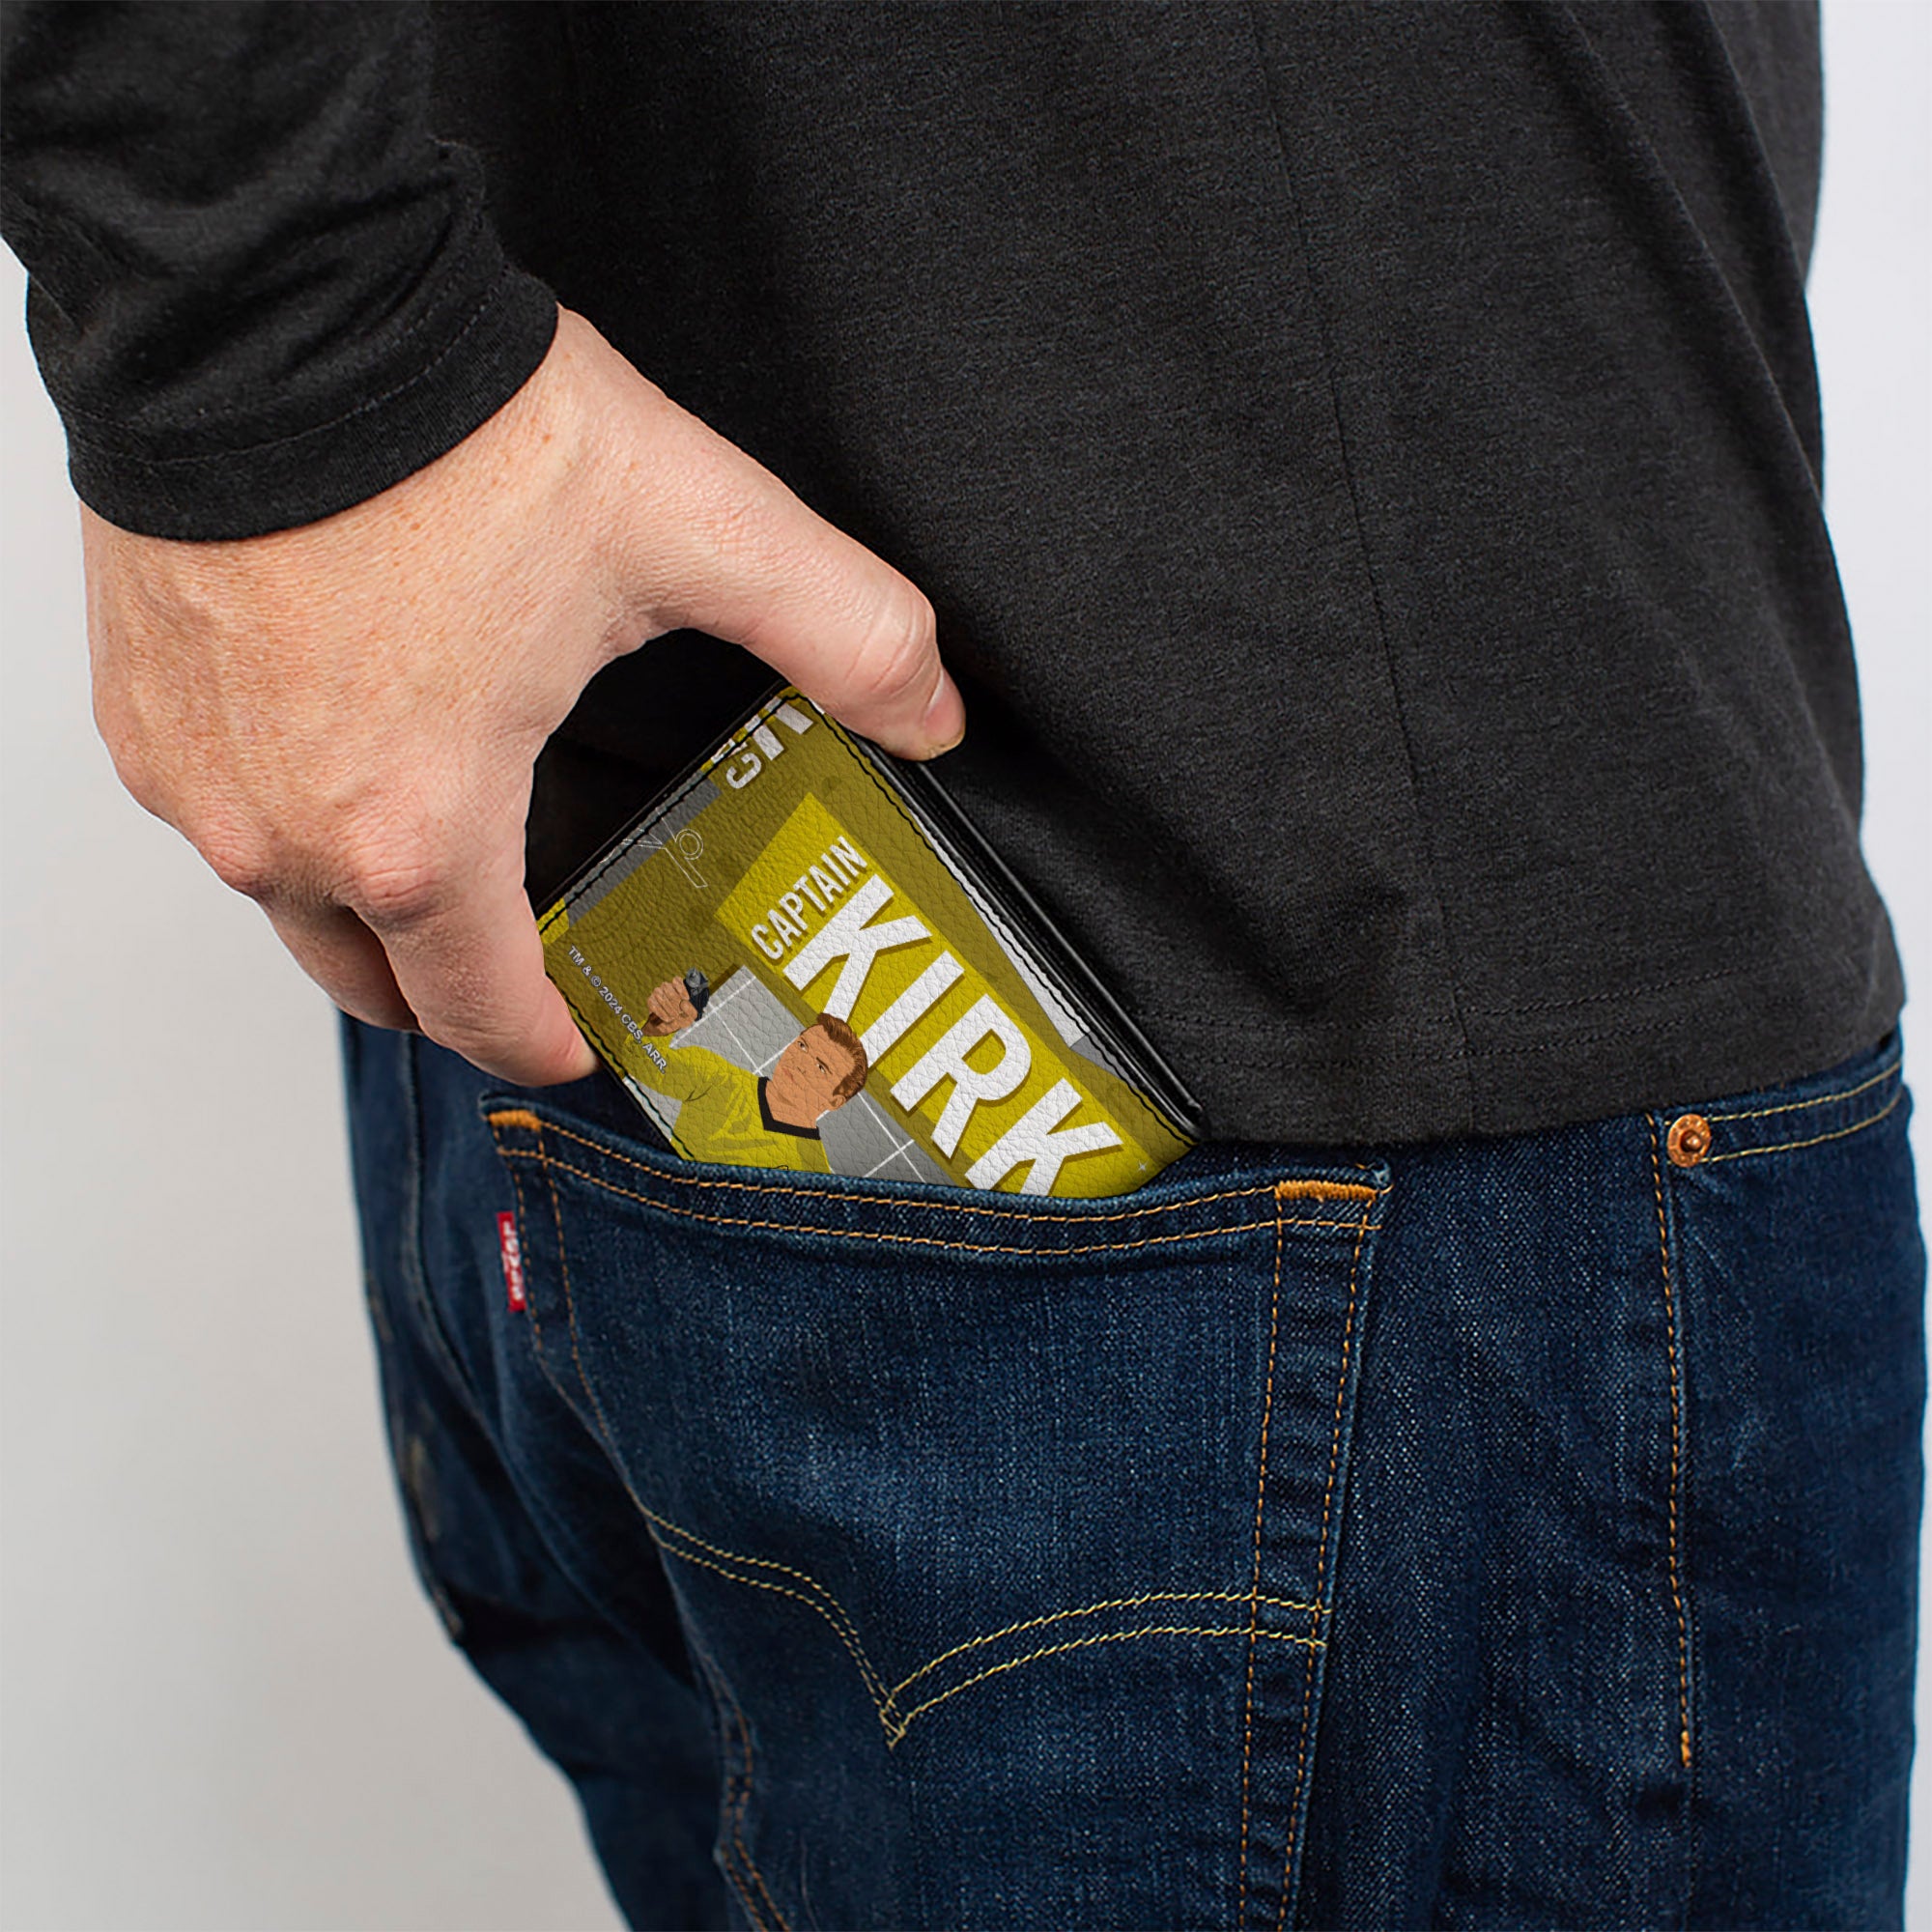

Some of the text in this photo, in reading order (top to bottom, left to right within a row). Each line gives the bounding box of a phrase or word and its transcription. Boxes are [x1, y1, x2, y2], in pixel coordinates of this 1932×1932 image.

[751, 836, 868, 960] CAPTAIN
[568, 945, 585, 966] TM
[582, 966, 592, 977] &
[599, 986, 623, 1014] 2024
[642, 1042, 667, 1074] ARR.
[782, 873, 1123, 1196] KIRK
